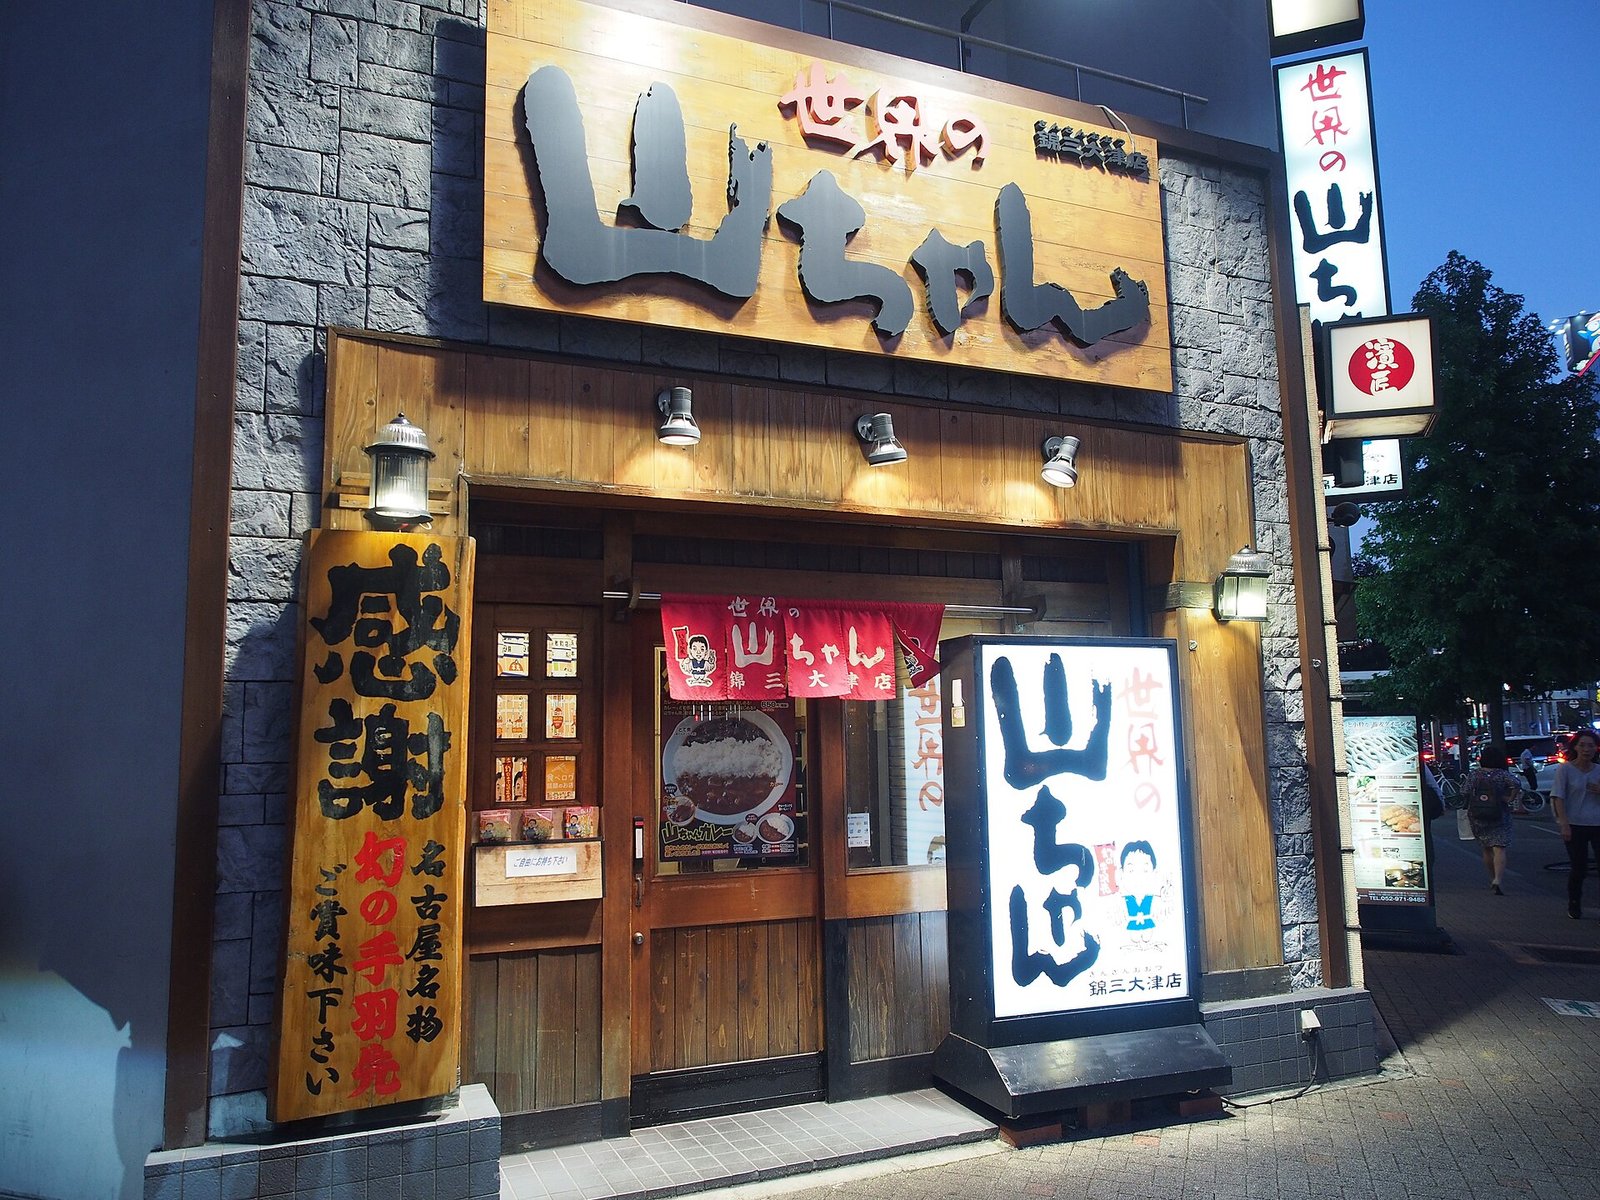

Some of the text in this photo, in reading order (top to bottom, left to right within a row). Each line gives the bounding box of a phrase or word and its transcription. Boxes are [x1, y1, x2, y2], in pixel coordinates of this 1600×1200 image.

[778, 61, 990, 171] 世界の
[1033, 130, 1149, 173] 錦三大津店
[519, 64, 1150, 348] 山ちゃん
[310, 542, 461, 821] 感謝
[728, 596, 801, 619] 世界の
[731, 621, 886, 669] 山ちゃん
[1118, 666, 1165, 814] 世界の
[513, 856, 569, 869] ご自由にお持ち下さい
[990, 652, 1112, 988] 山ちゃん
[305, 864, 349, 1098] ご賞味下さい
[348, 829, 408, 1101] 幻の手羽先
[405, 838, 449, 1045] 名古屋名物
[1089, 972, 1182, 997] 錦三大津店
